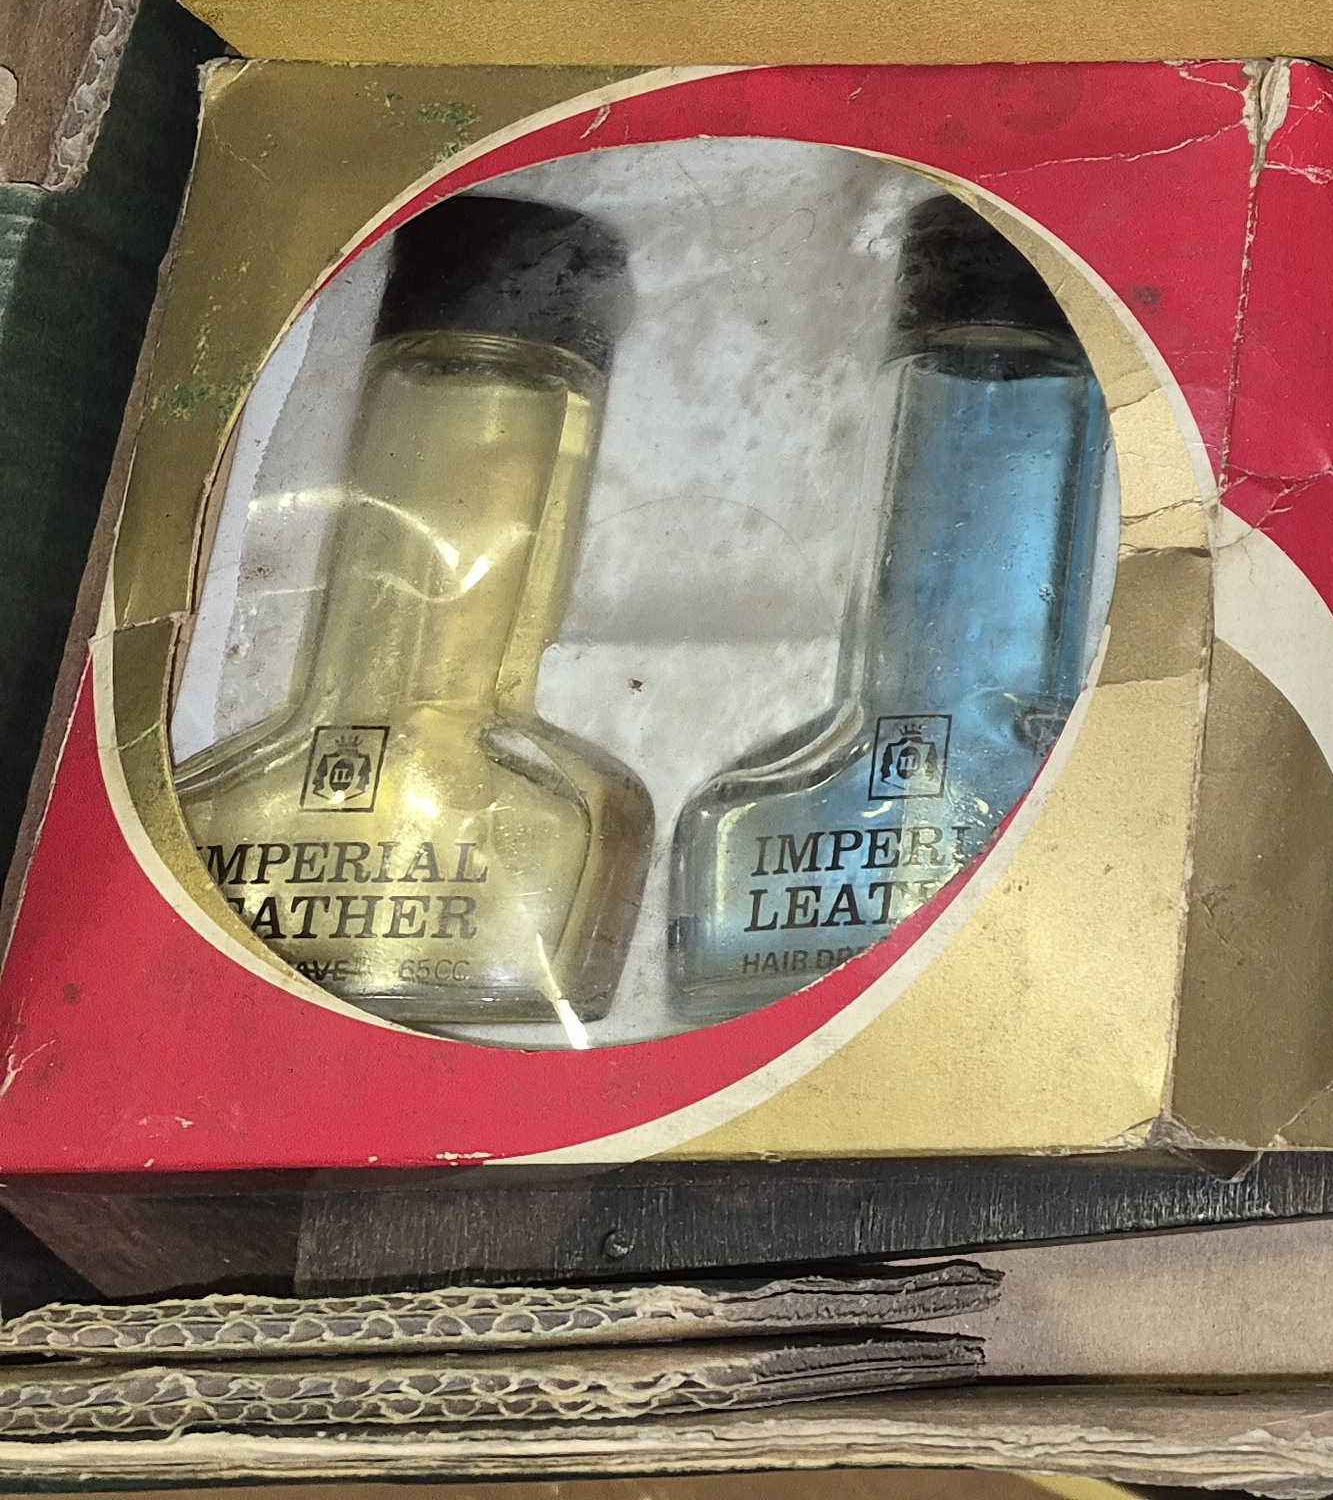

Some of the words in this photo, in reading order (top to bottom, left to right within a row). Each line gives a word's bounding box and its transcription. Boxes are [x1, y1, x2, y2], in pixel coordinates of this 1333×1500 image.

[196, 842, 489, 885] MPERIAL
[751, 826, 998, 876] IMPERI
[227, 896, 478, 939] ATHER
[744, 881, 938, 932] LEAT
[742, 949, 808, 974] HAIR
